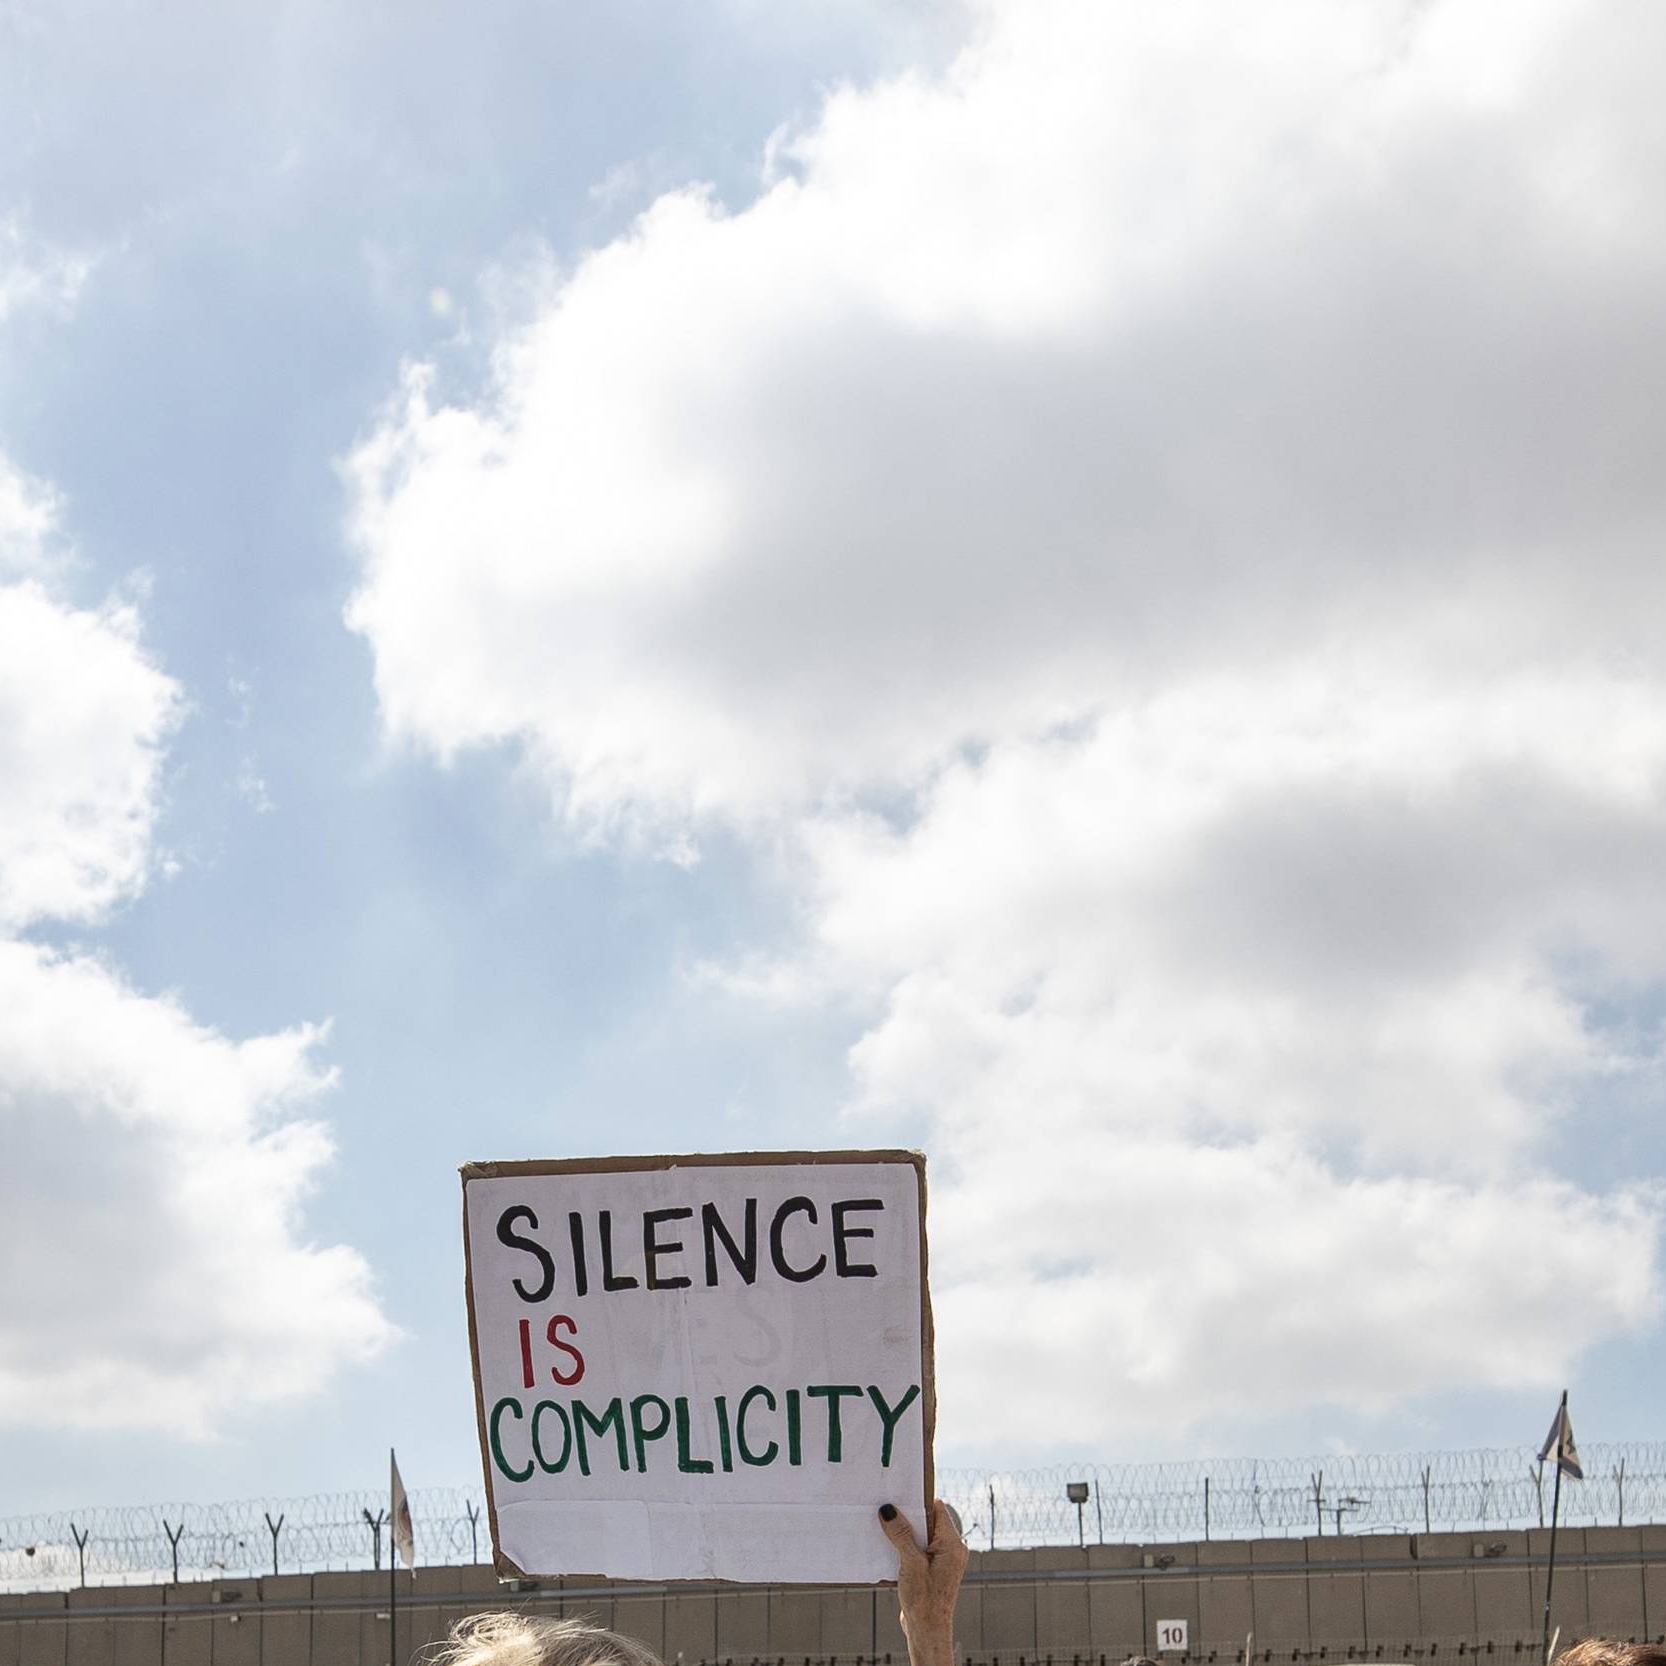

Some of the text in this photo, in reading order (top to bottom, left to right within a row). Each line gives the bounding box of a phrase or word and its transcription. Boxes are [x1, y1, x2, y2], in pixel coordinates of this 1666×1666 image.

[496, 1196, 884, 1303] SILENCE
[519, 1314, 585, 1388] IS
[490, 1384, 920, 1482] COMPLICITY
[1162, 1626, 1183, 1645] 10
